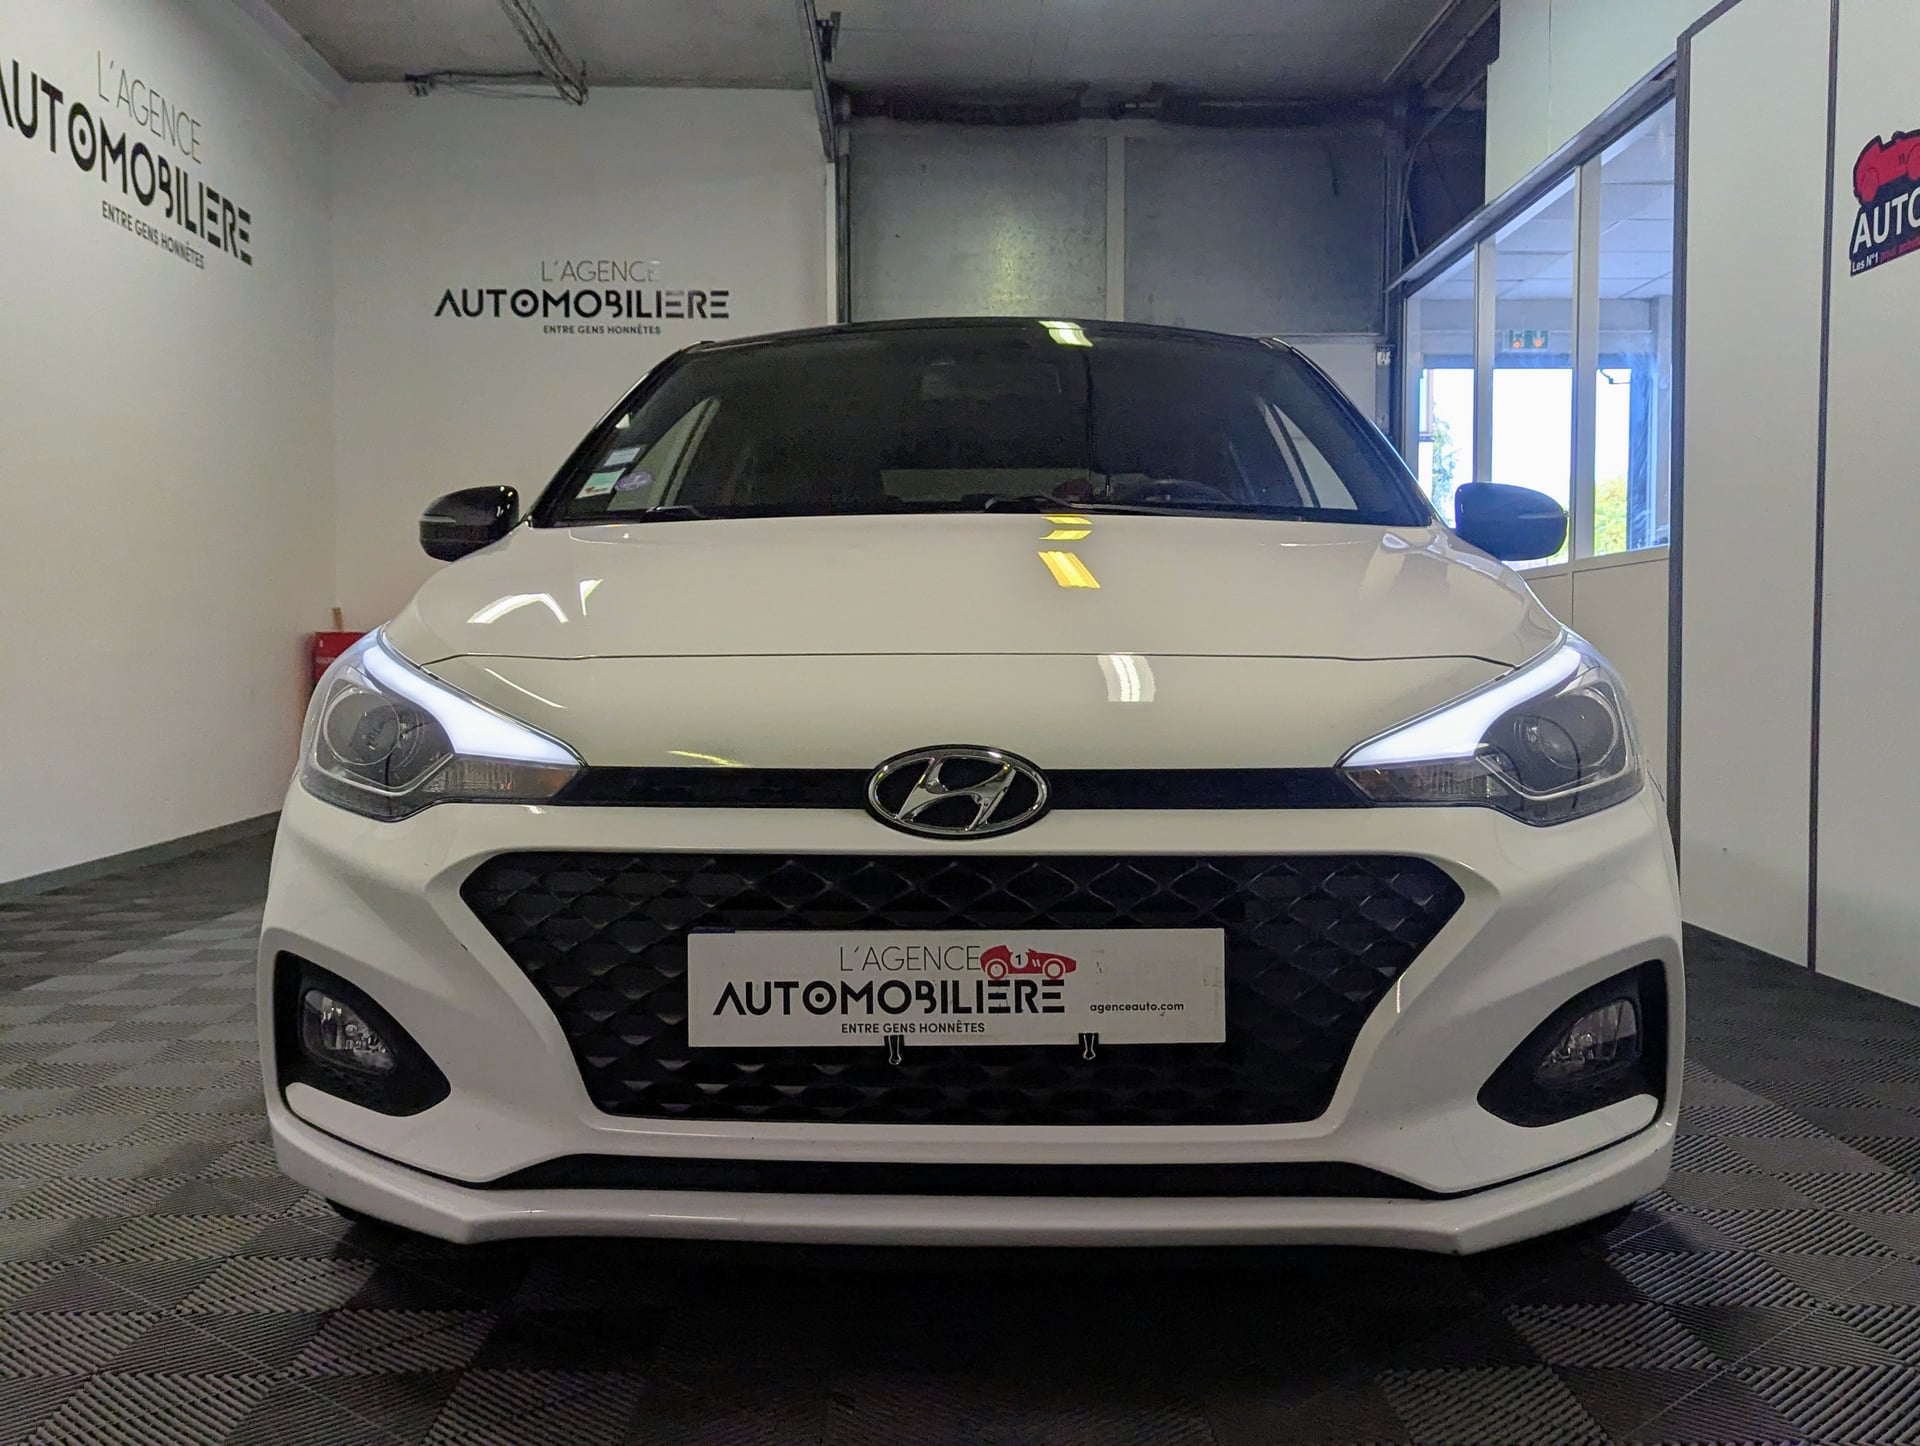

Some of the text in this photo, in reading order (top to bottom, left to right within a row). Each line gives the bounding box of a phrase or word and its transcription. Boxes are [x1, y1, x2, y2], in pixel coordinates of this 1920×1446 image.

[97, 50, 202, 164] L'AGENCE
[102, 199, 133, 232] ENTRE
[135, 219, 159, 246] GENS
[1852, 260, 1865, 273] Les
[434, 288, 730, 318] AUTOMOBILIERE
[543, 323, 662, 335] ENTRE GENS HONNÊTES
[840, 945, 981, 971] L'AGENCE
[712, 979, 1066, 1016] AUTOMOBILIERE
[1089, 1002, 1184, 1014] agenceauto.com
[841, 1019, 986, 1034] ENTRE GENS HONNÊTES
